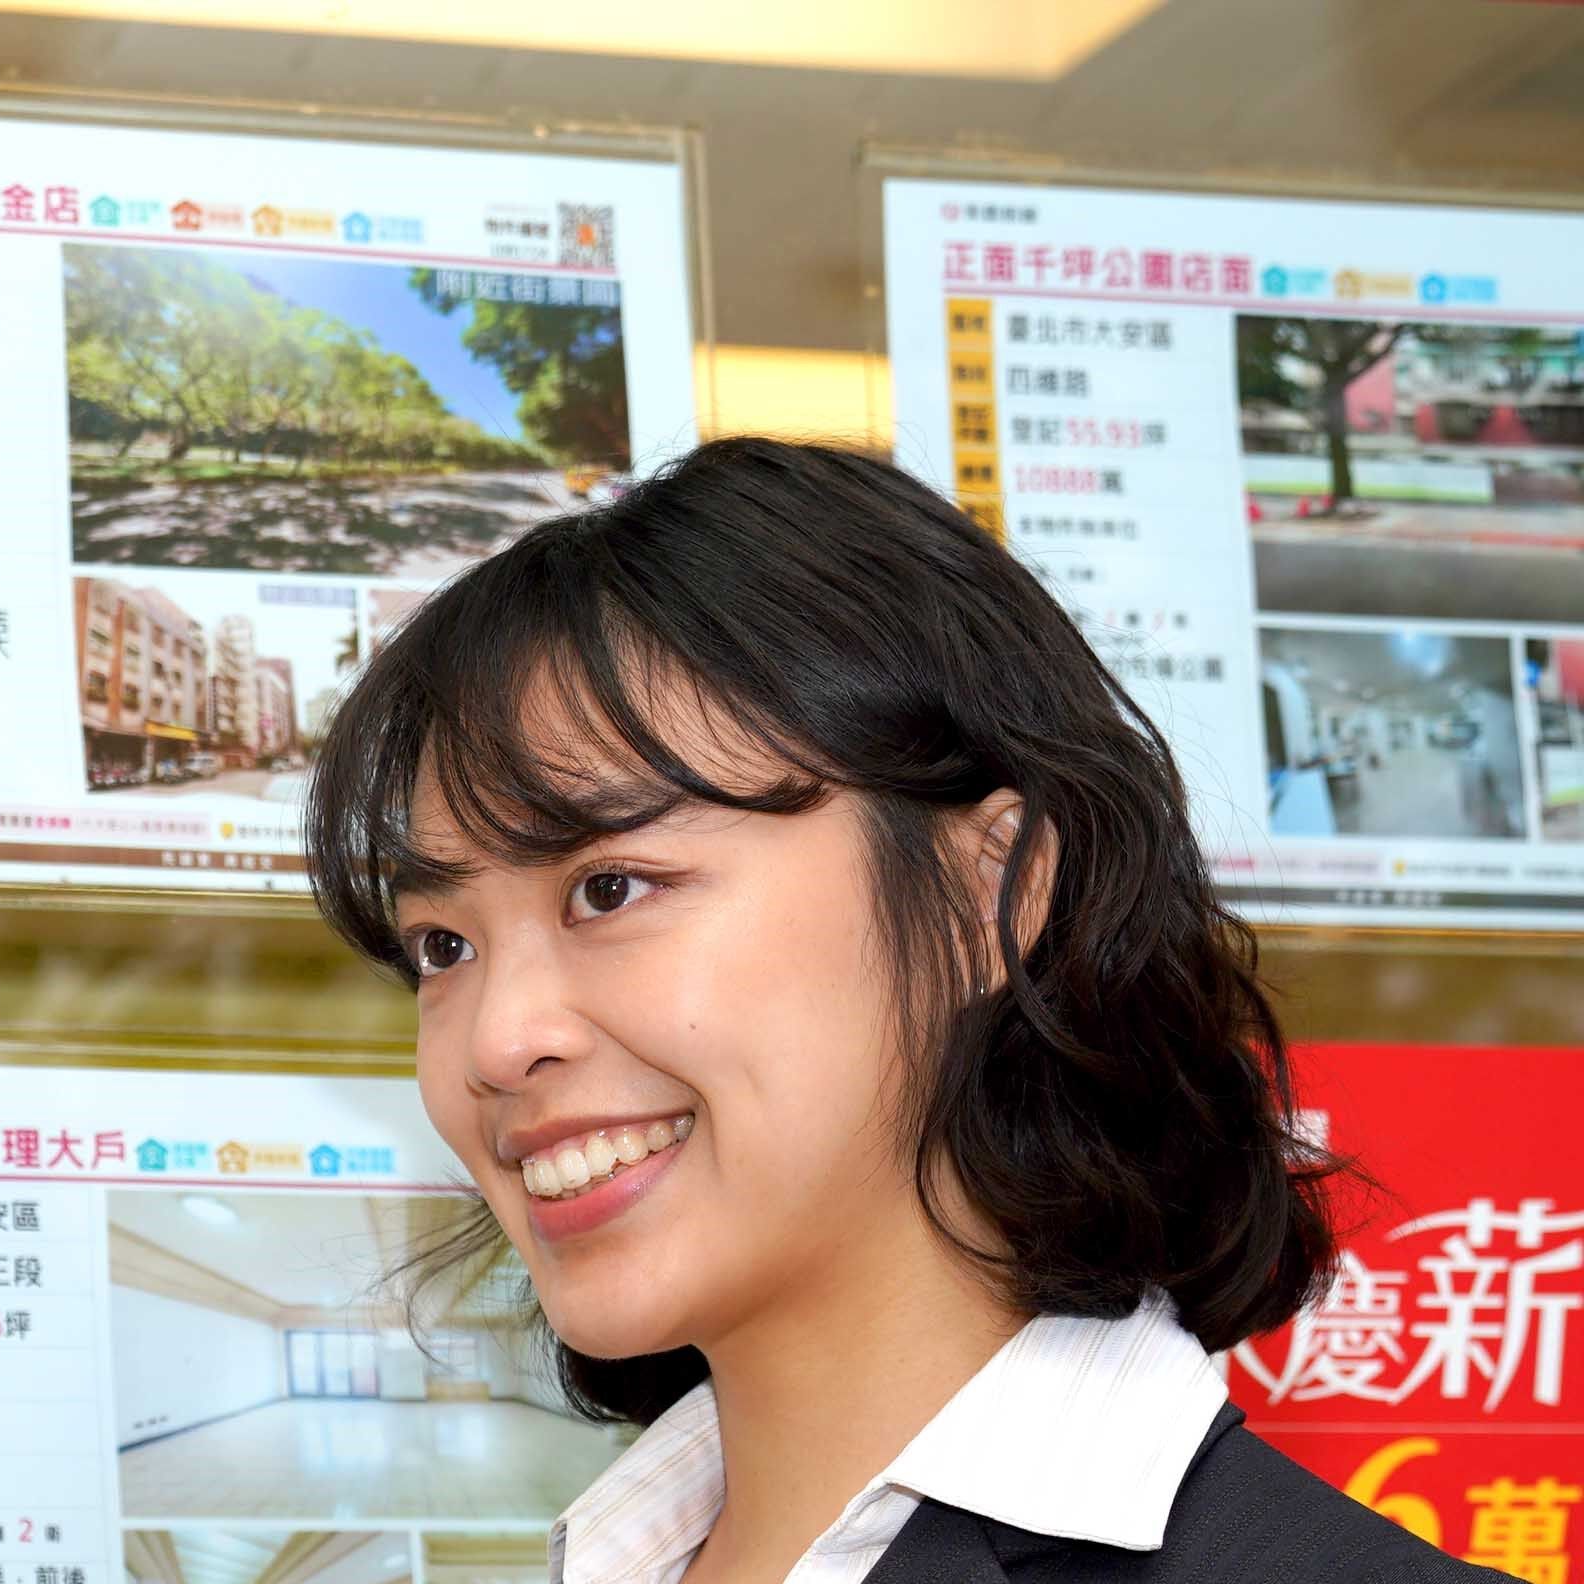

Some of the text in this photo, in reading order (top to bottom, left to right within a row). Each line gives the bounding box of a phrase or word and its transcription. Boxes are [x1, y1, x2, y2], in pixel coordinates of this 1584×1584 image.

[1008, 314, 1172, 349] 臺北市大安區
[19, 1518, 32, 1543] 2
